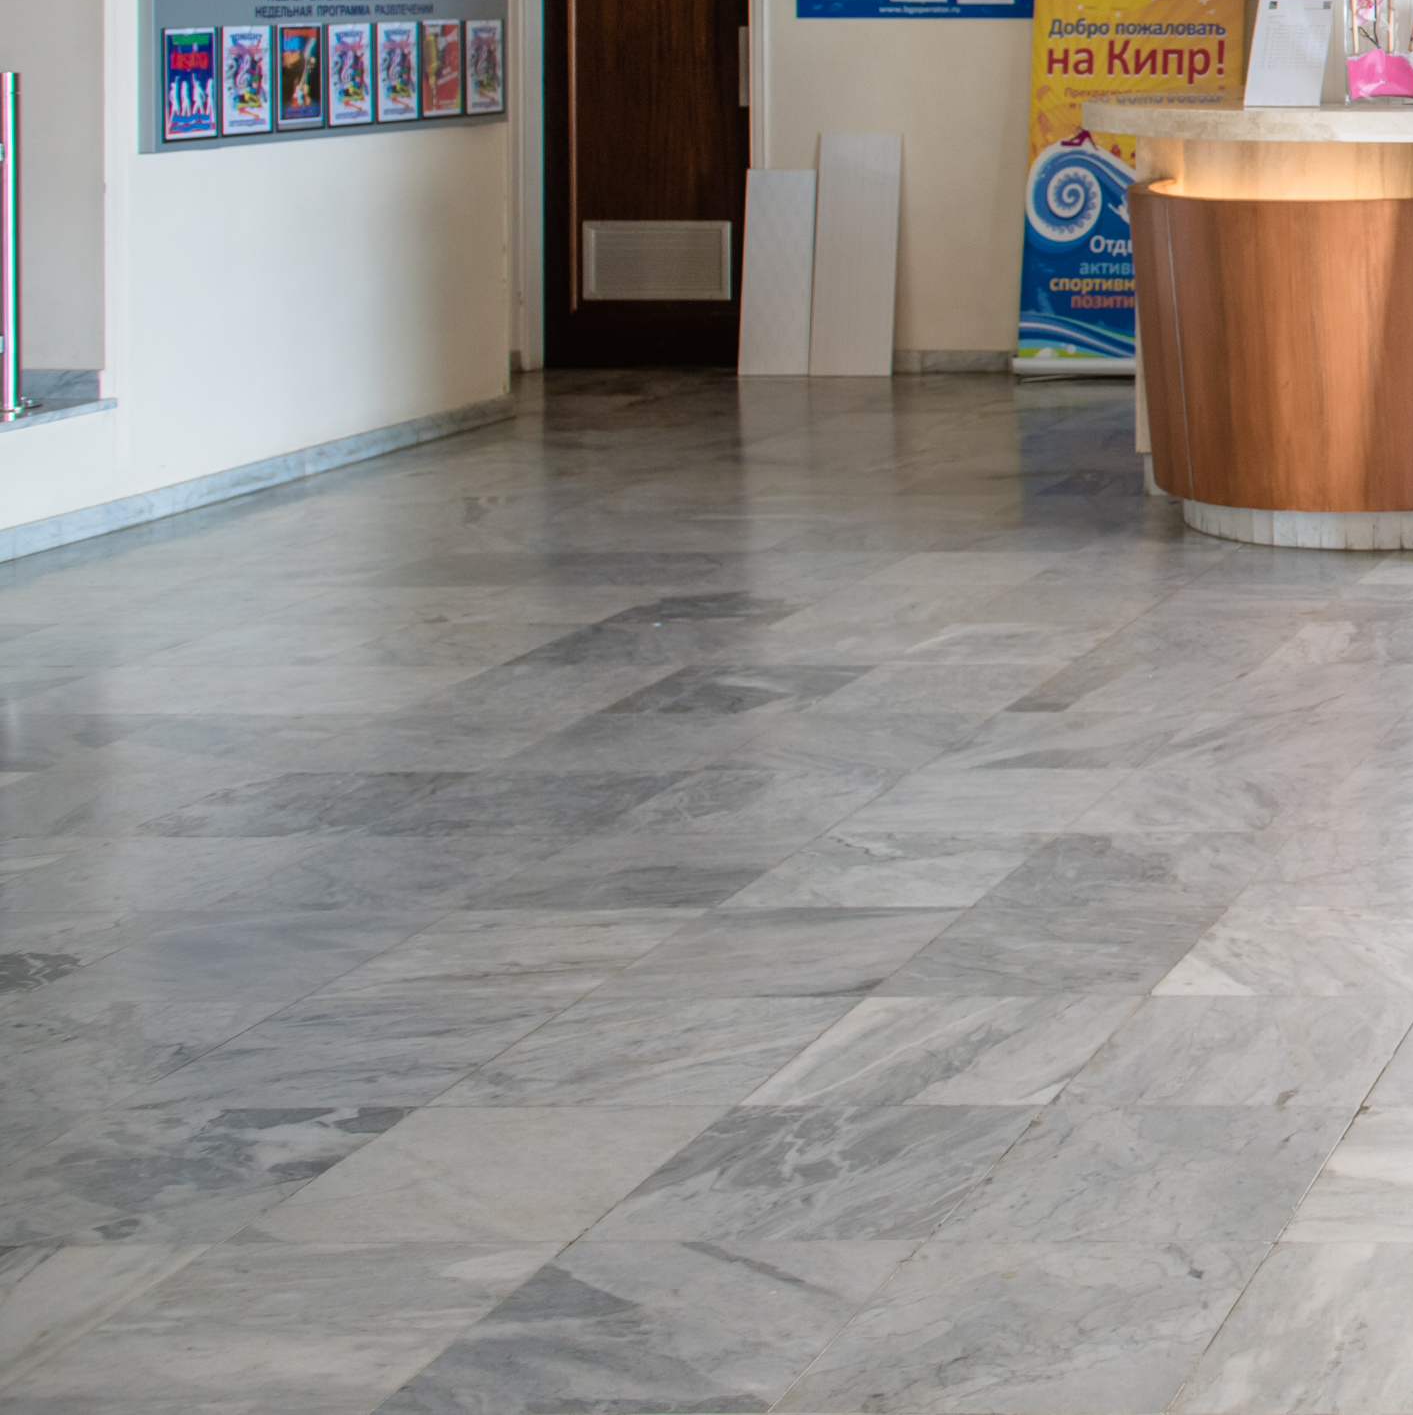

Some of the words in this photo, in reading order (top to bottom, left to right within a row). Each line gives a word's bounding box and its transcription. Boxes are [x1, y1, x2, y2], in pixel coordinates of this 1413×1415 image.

[254, 5, 313, 18] НЕДЕЛЬНАЯ
[316, 4, 371, 16] ПРОГРАММА
[1048, 18, 1111, 40] Добро
[1115, 21, 1227, 37] пожаловать
[1047, 47, 1095, 77] на
[1107, 39, 1226, 86] Кипр!
